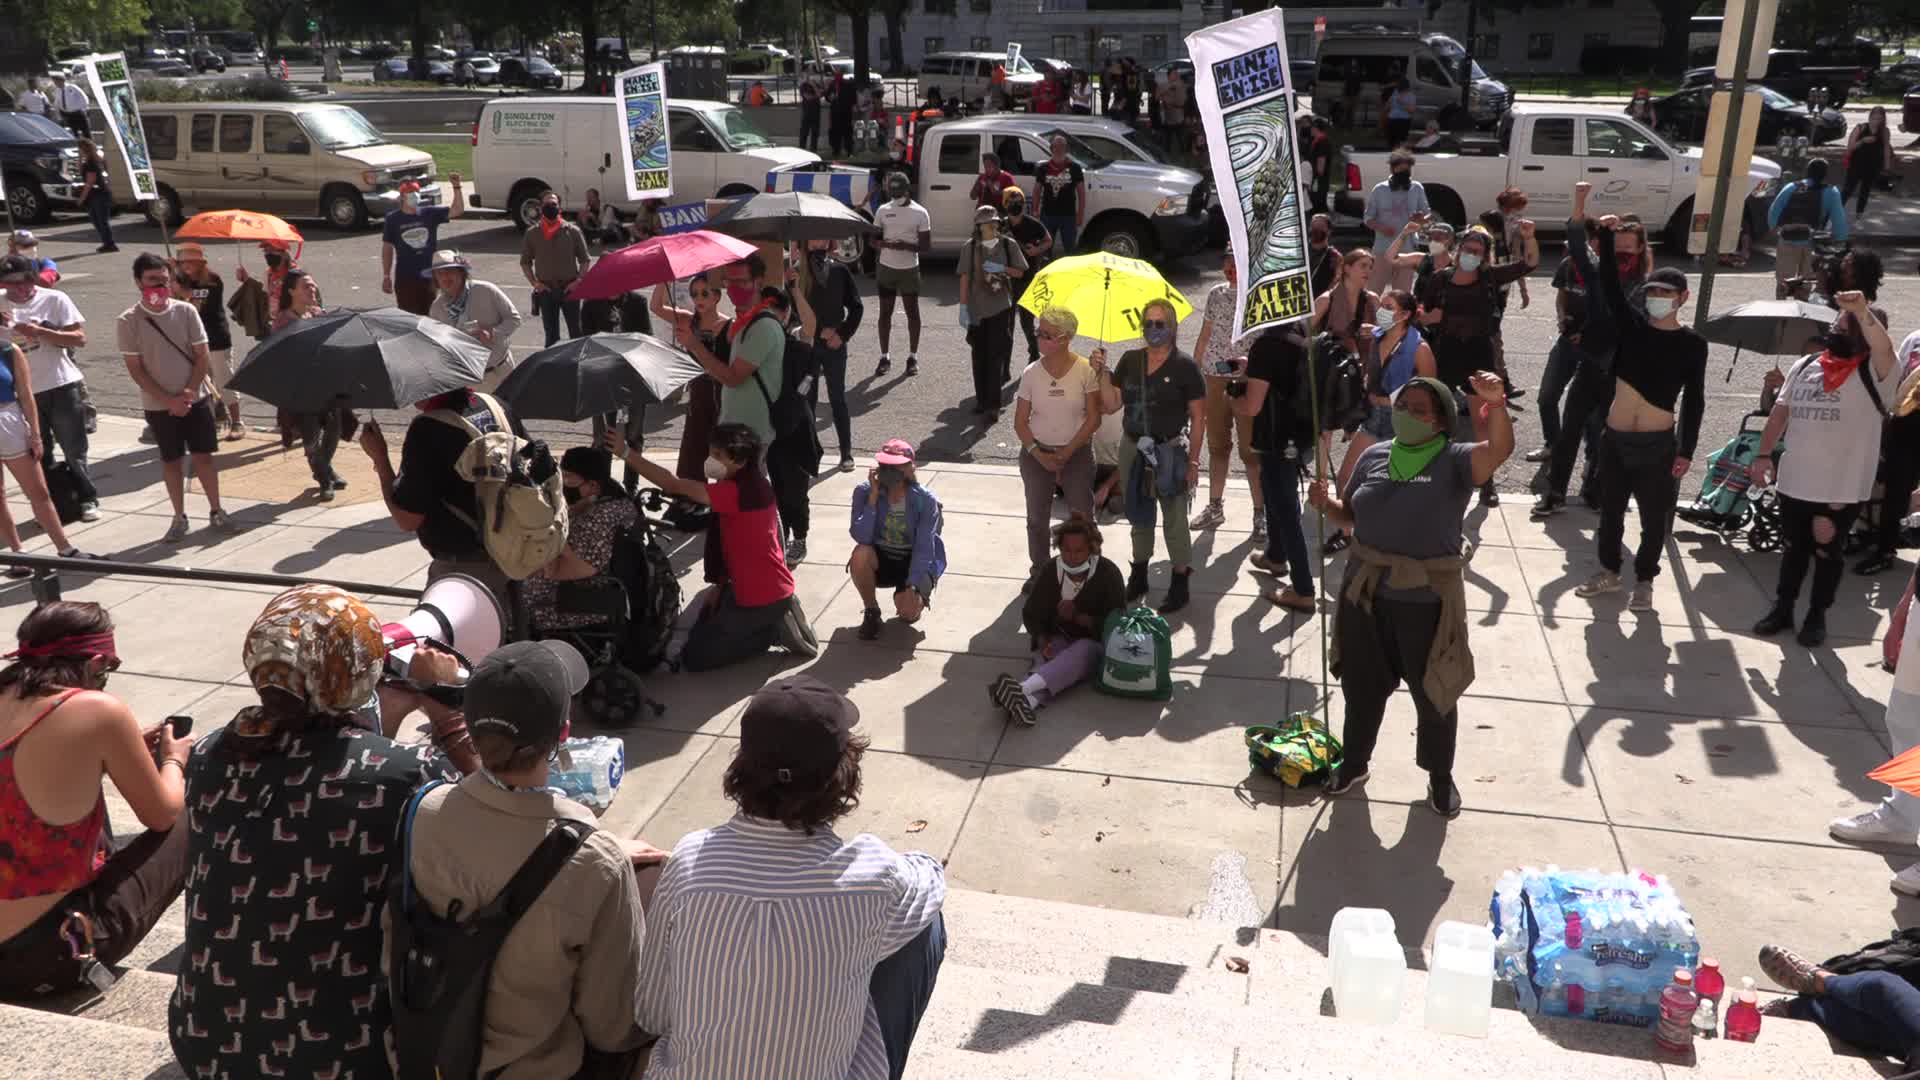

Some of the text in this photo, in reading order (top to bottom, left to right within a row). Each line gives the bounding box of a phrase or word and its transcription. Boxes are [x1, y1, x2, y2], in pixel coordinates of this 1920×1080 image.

[1216, 49, 1276, 84] MANI:
[504, 112, 554, 120] SINGLETON
[1261, 295, 1309, 320] ALIVE
[1793, 389, 1841, 402] LIVES
